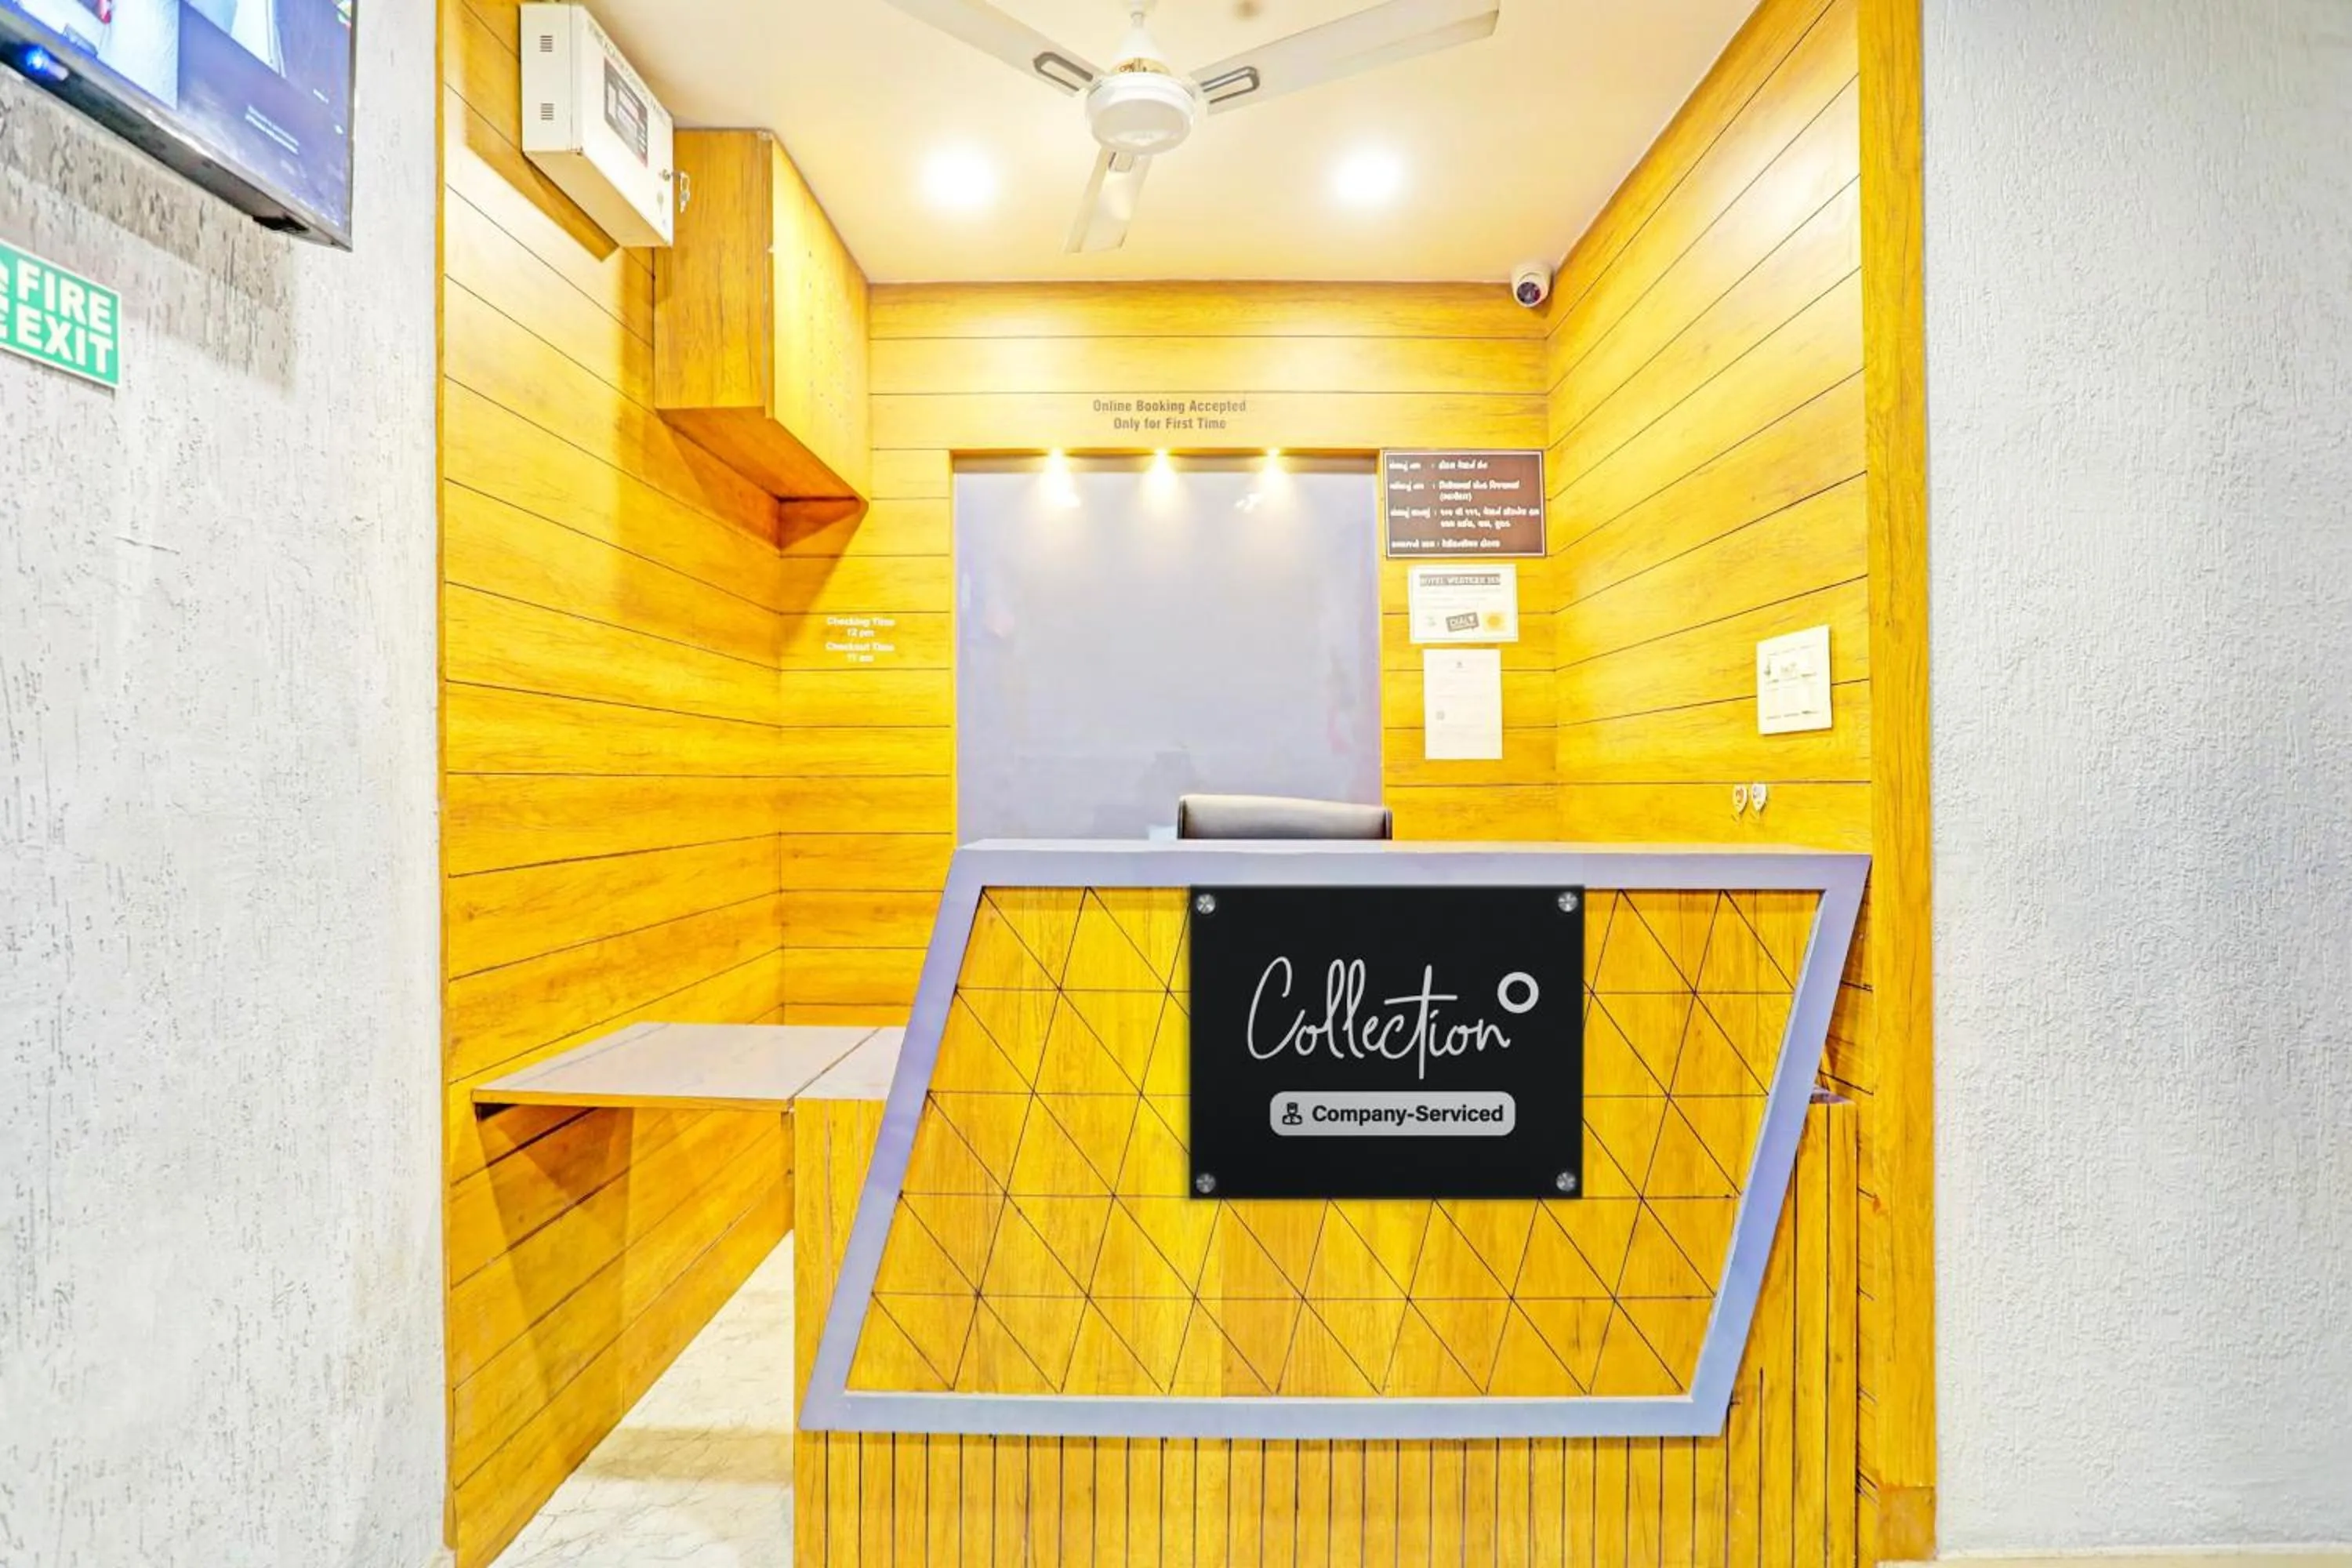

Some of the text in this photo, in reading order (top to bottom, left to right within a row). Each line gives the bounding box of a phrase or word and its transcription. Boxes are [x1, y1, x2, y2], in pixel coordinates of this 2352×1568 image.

[17, 258, 112, 335] FIRE
[16, 303, 114, 374] EXIT
[1093, 399, 1247, 415] Online Booking Accepted
[1114, 417, 1226, 431] Only for First Time
[1247, 956, 1511, 1080] Collection
[1312, 1104, 1504, 1127] Company-Serviced
